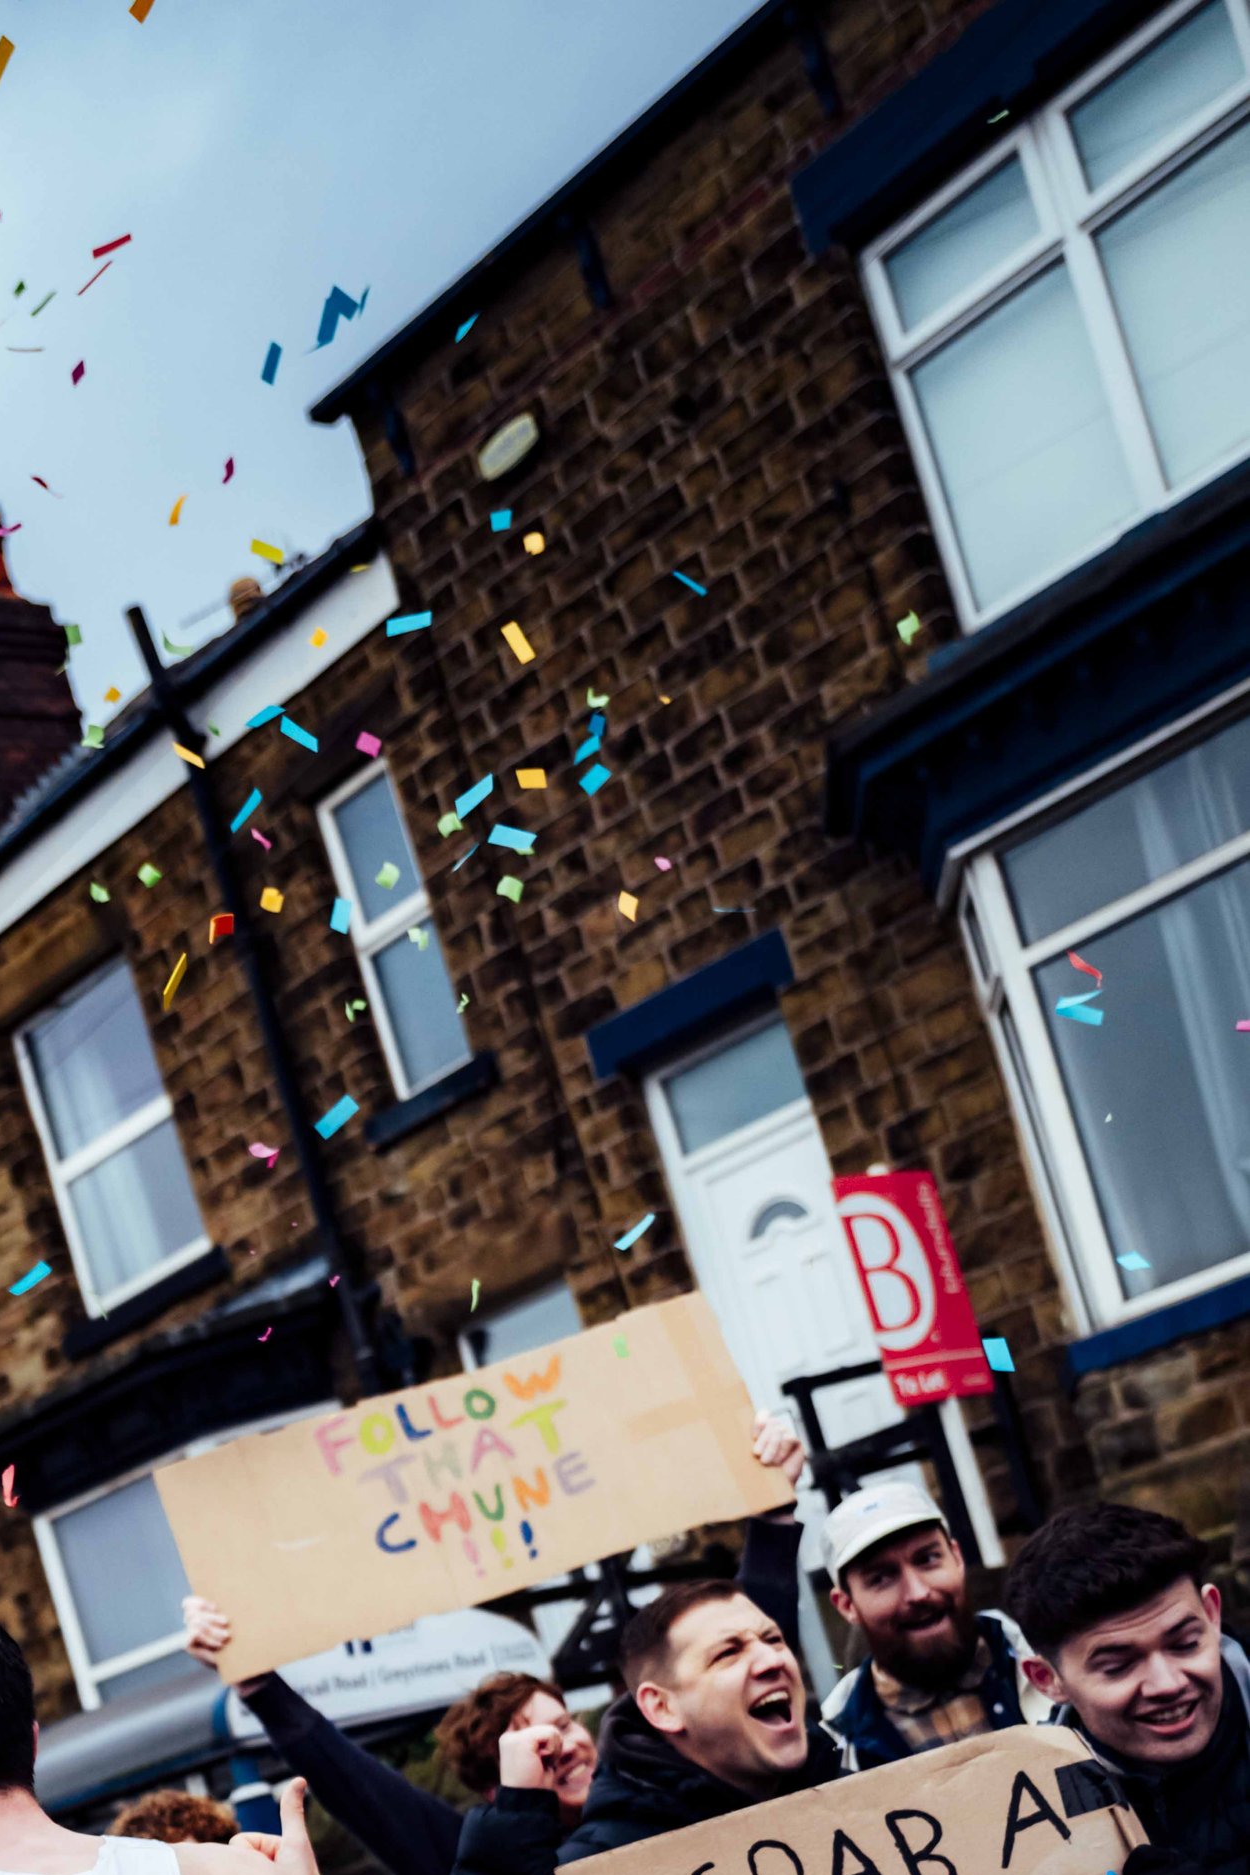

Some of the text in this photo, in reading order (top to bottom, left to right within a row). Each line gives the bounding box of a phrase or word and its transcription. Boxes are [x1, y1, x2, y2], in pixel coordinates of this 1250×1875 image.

[315, 1356, 562, 1476] FOLLOW
[357, 1401, 566, 1503] THAT
[375, 1451, 595, 1553] CHUNE
[1002, 1771, 1071, 1869] A
